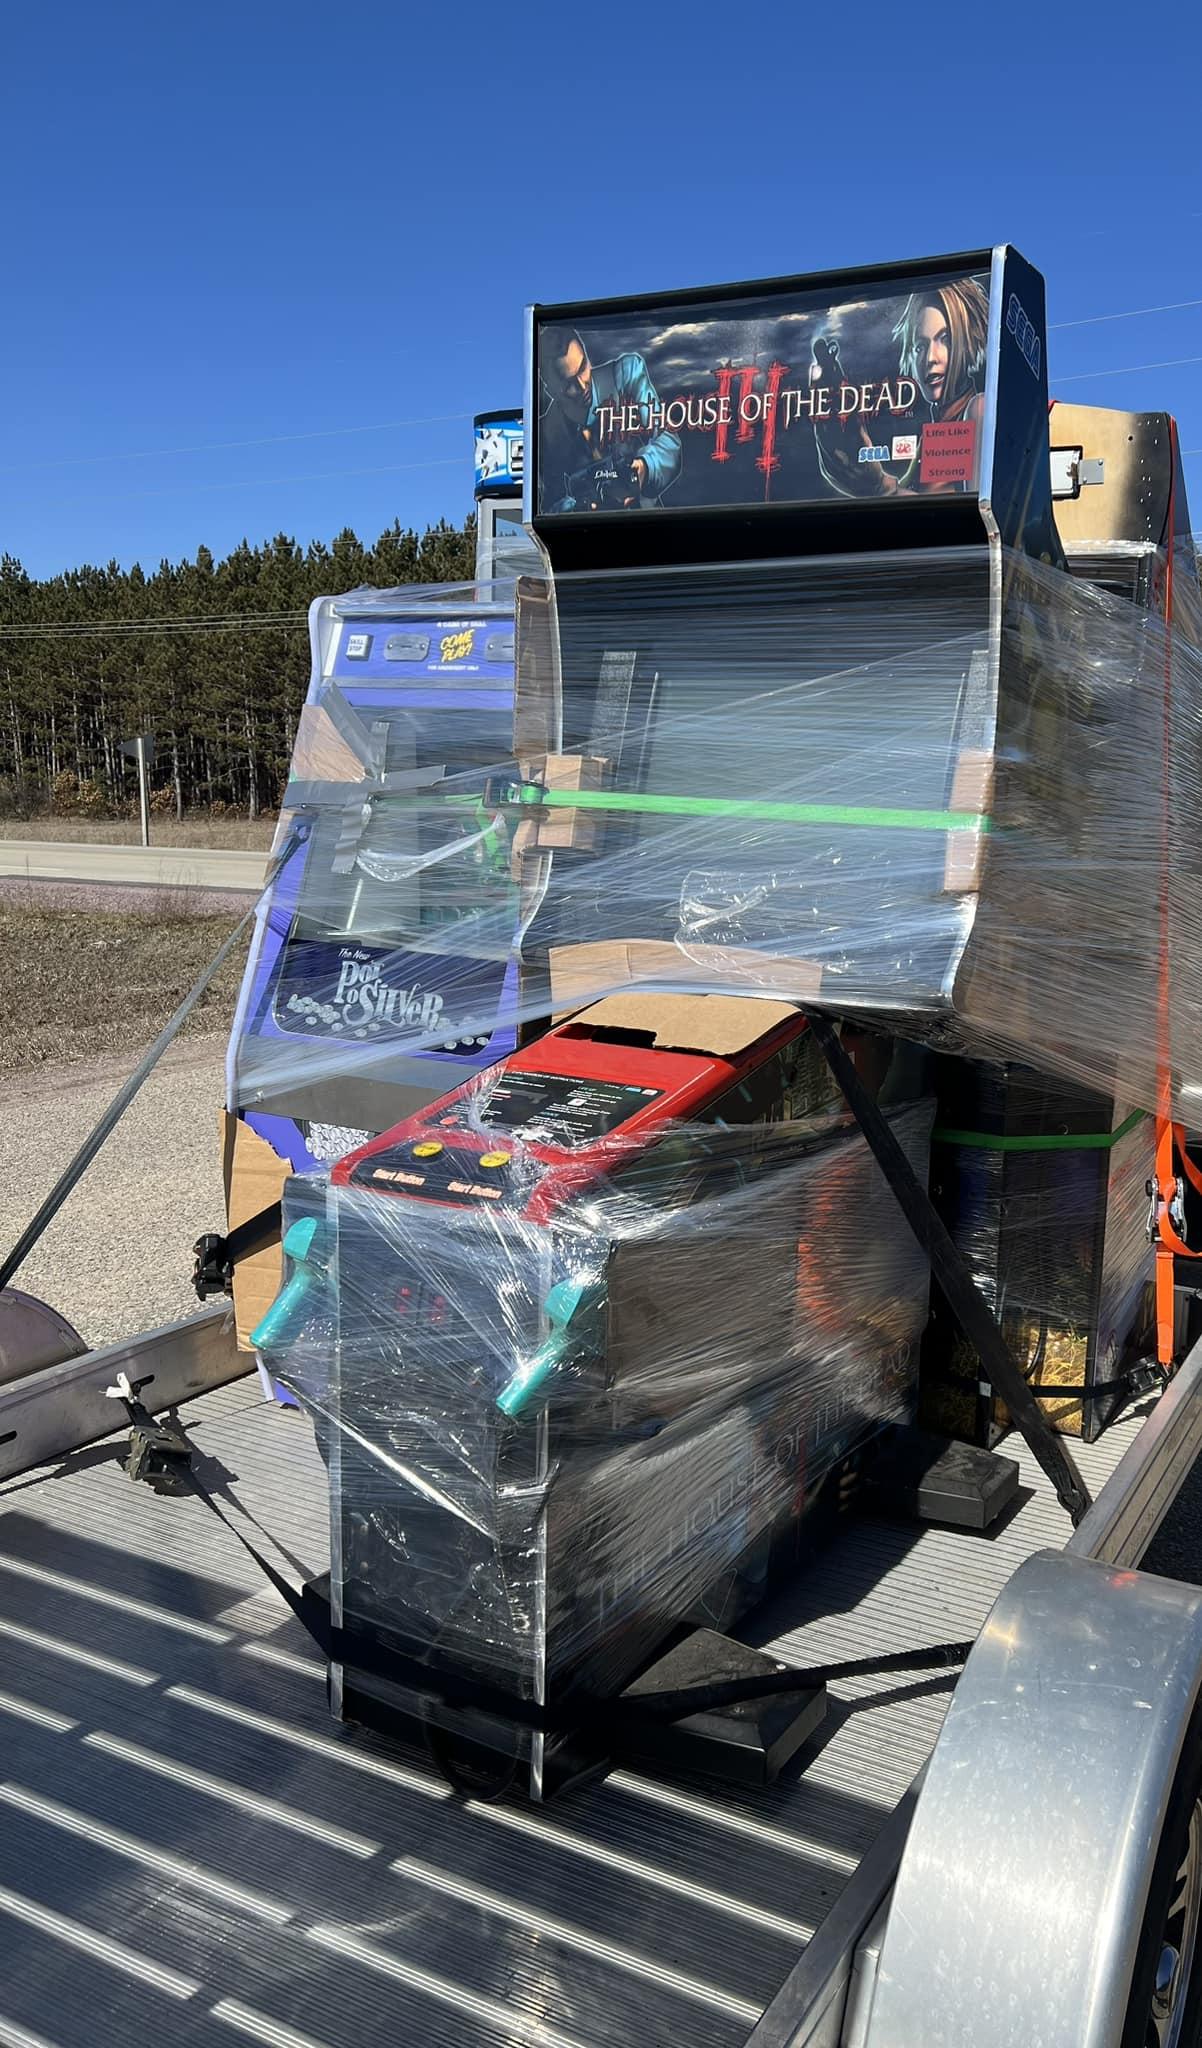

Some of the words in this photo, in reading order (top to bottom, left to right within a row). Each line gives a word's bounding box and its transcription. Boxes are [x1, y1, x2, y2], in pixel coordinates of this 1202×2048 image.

[1006, 293, 1041, 381] SEGA
[594, 404, 641, 442] THE
[647, 396, 732, 430] HOUSE
[740, 392, 774, 421] OF
[780, 387, 832, 429] THE
[838, 380, 917, 415] DEAD
[925, 429, 945, 438] Life
[947, 427, 970, 437] Like
[858, 446, 891, 462] SEGA
[924, 447, 972, 457] Violence
[928, 467, 966, 477] Strong
[440, 629, 475, 650] COME
[338, 948, 352, 957] The
[352, 950, 371, 960] New
